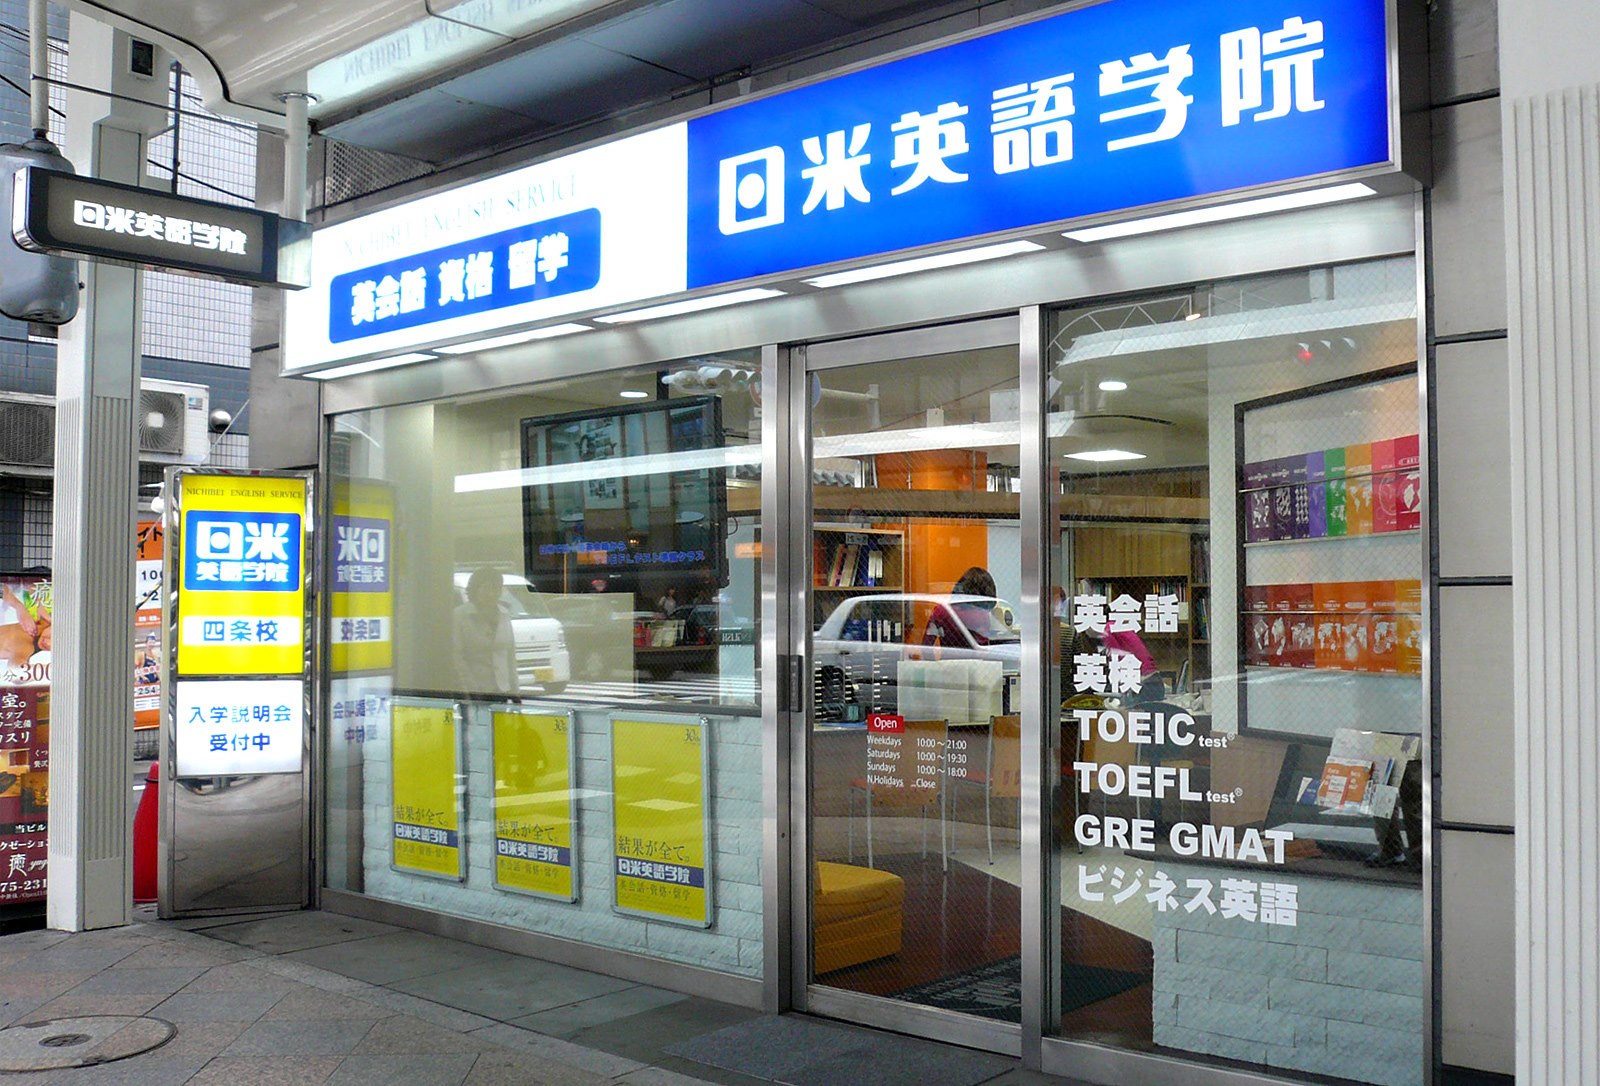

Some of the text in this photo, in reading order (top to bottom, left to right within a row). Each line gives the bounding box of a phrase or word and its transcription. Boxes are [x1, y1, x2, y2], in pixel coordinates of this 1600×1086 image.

[719, 16, 1326, 236] 日米英語学院
[74, 199, 247, 255] 日米英語学院
[351, 231, 569, 326] 英会話 資格 留学
[185, 487, 304, 499] NICHIBEI ENGLISH SERVICE
[196, 521, 289, 561] 日米
[195, 561, 289, 583] 英語学院
[1073, 594, 1180, 633] 英会話
[203, 620, 279, 642] 四条校
[1073, 652, 1143, 695] 英検
[189, 704, 291, 723] 入学説明会
[874, 717, 897, 730] Open
[1073, 709, 1196, 746] TOEIC
[209, 733, 270, 752] 受付中
[866, 735, 902, 748] Weekdays
[916, 738, 936, 748] 10:00
[947, 739, 967, 750] 21:00
[866, 747, 901, 761] Saturdays
[916, 751, 936, 762] 10:00
[947, 753, 967, 764] 19:30
[866, 760, 896, 773] Sundays
[916, 764, 936, 775] 10:00
[947, 767, 967, 778] 18:00
[1073, 761, 1202, 801] TOEFL
[916, 778, 936, 789] Close
[498, 839, 559, 862] 日米英語学院
[618, 836, 690, 863] 結果が全て。
[1074, 814, 1294, 864] GRE GMAT
[618, 858, 691, 884] 日米英語学院
[1077, 865, 1299, 926] ビジネス英語
